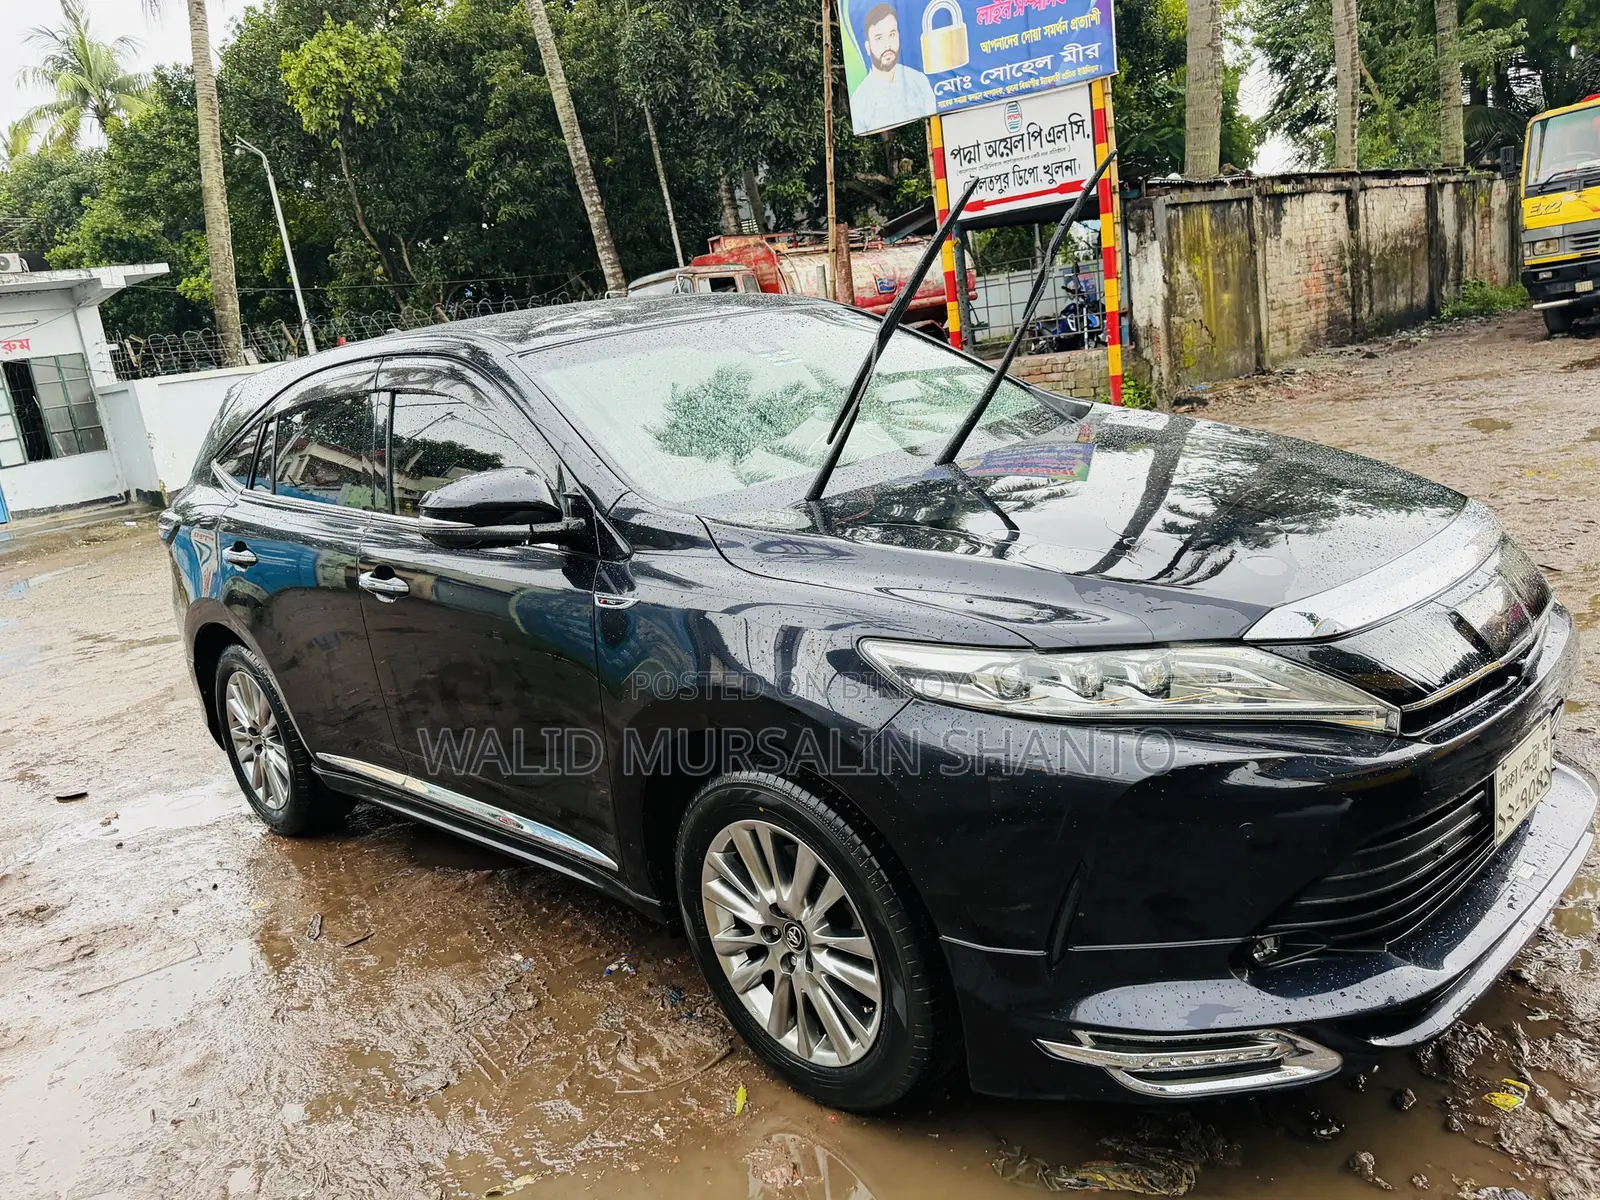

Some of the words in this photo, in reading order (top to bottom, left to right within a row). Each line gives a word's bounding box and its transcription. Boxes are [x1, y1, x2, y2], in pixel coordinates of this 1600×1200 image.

[976, 0, 1011, 25] লাইন
[980, 33, 1019, 54] আপনাদের
[1021, 27, 1042, 45] দোয়া
[1043, 17, 1068, 38] সমর্থন
[1070, 7, 1101, 31] প্রত্যাশী
[934, 75, 972, 96] মোঃ
[980, 54, 1054, 84] সোহেল
[1059, 43, 1102, 64] মীর
[950, 139, 981, 168] পদ্মা
[984, 133, 1025, 158] অয়েল
[1026, 122, 1043, 151] পি
[1045, 123, 1068, 145] এল
